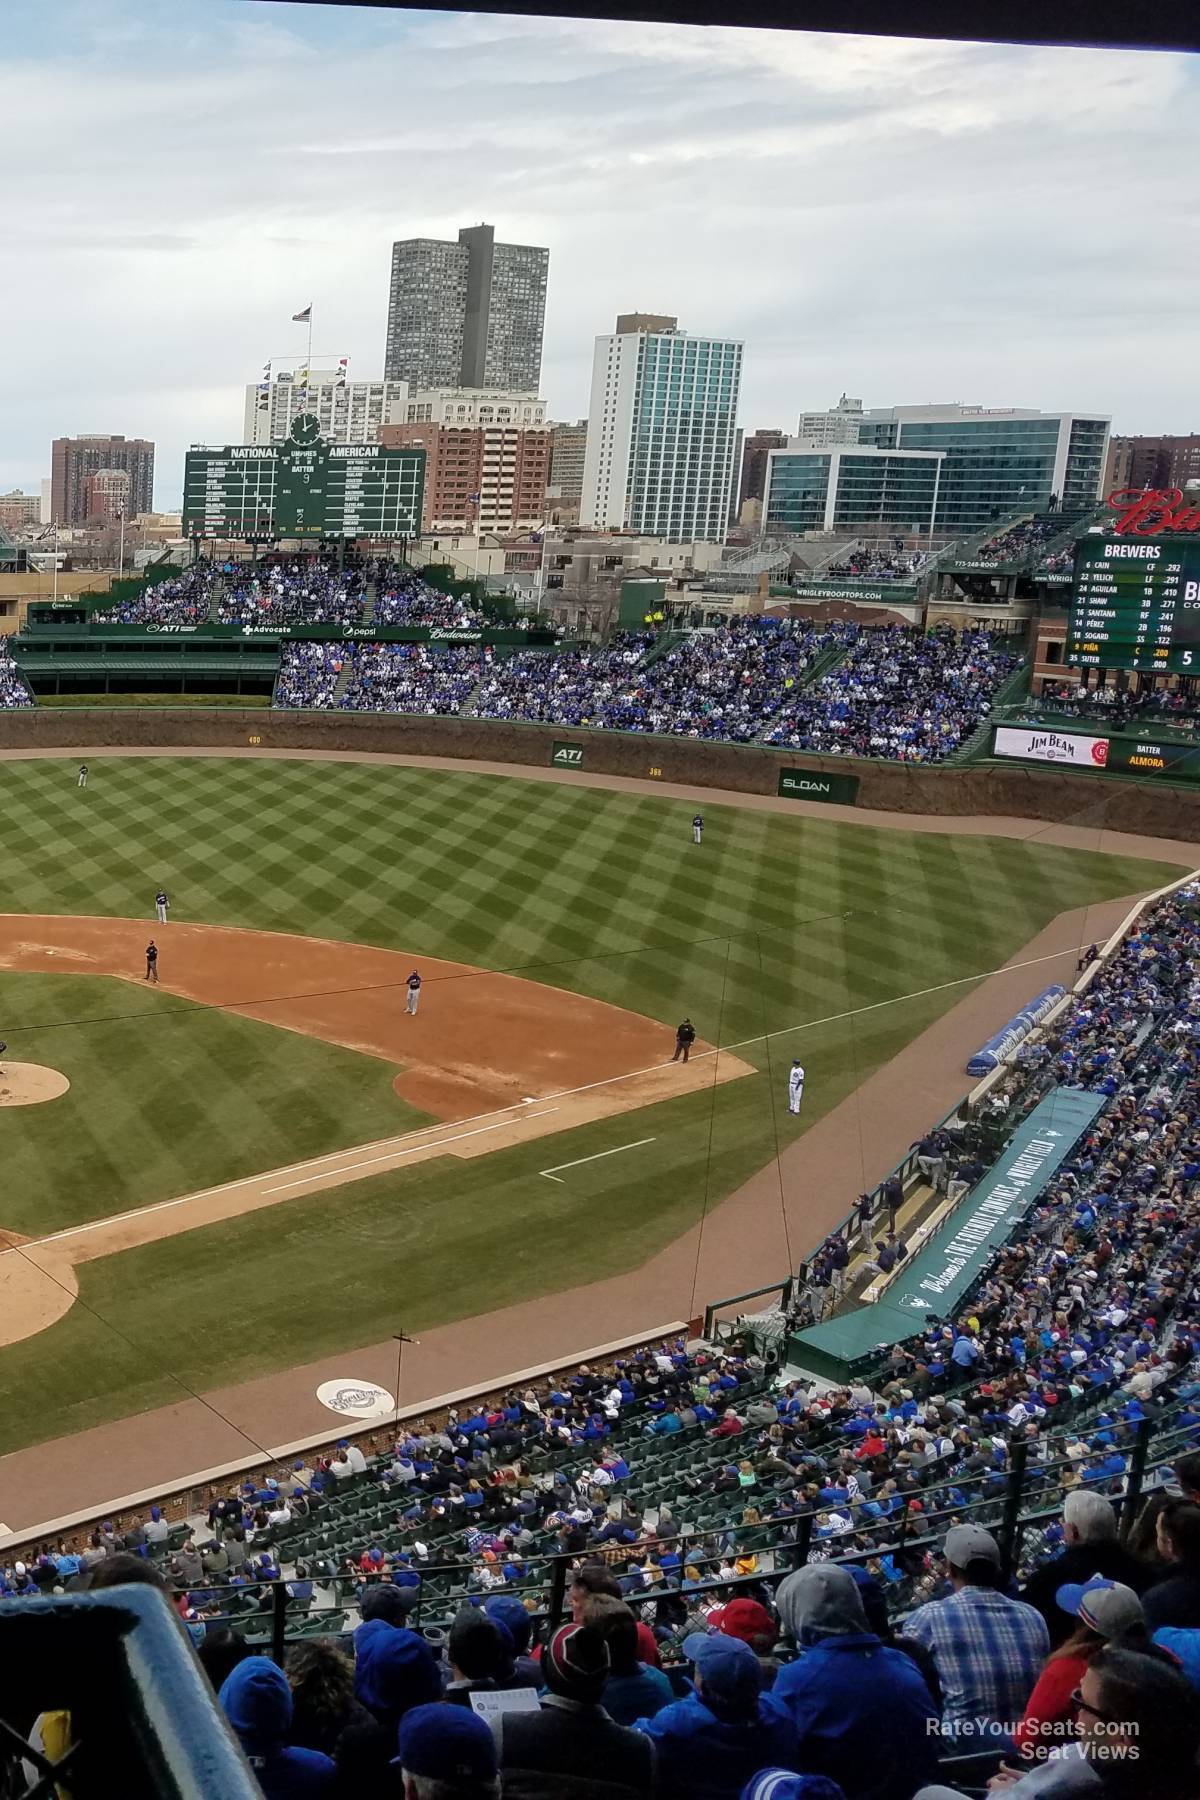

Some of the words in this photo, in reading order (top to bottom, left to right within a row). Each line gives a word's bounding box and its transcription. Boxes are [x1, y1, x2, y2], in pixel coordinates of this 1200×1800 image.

[231, 448, 279, 458] NATIONAL
[329, 447, 379, 457] AMERICAN
[303, 474, 309, 483] 9
[297, 514, 303, 523] 2
[1104, 544, 1161, 558] BREWERS
[1165, 564, 1180, 572] .292
[797, 589, 882, 600] WRIGLEYROOFTOPS.COM
[1091, 585, 1117, 593] AGUILAR
[1089, 597, 1107, 605] SHAW
[1087, 609, 1116, 618] SANTANA
[1086, 619, 1104, 628] PÉREZ
[354, 628, 376, 636] pepsi
[429, 628, 482, 639] Budweiser
[1083, 642, 1098, 651] PIÑA
[1153, 649, 1168, 657] .200
[1081, 655, 1099, 663] SUTER
[1182, 651, 1192, 666] 5
[1028, 736, 1047, 752] JIM
[1049, 734, 1075, 757] BEAM
[1137, 745, 1160, 755] BATTER
[555, 749, 583, 760] ATI
[1129, 756, 1164, 767] ALMORA
[783, 779, 830, 792] SLOAN
[1024, 1139, 1056, 1157] FIELD
[1006, 1152, 1045, 1179] WRIGLEY
[979, 1184, 1022, 1215] CONFINES
[955, 1211, 1000, 1245] FRIENDLY
[944, 1241, 978, 1258] THE
[920, 1262, 962, 1294] Welcome
